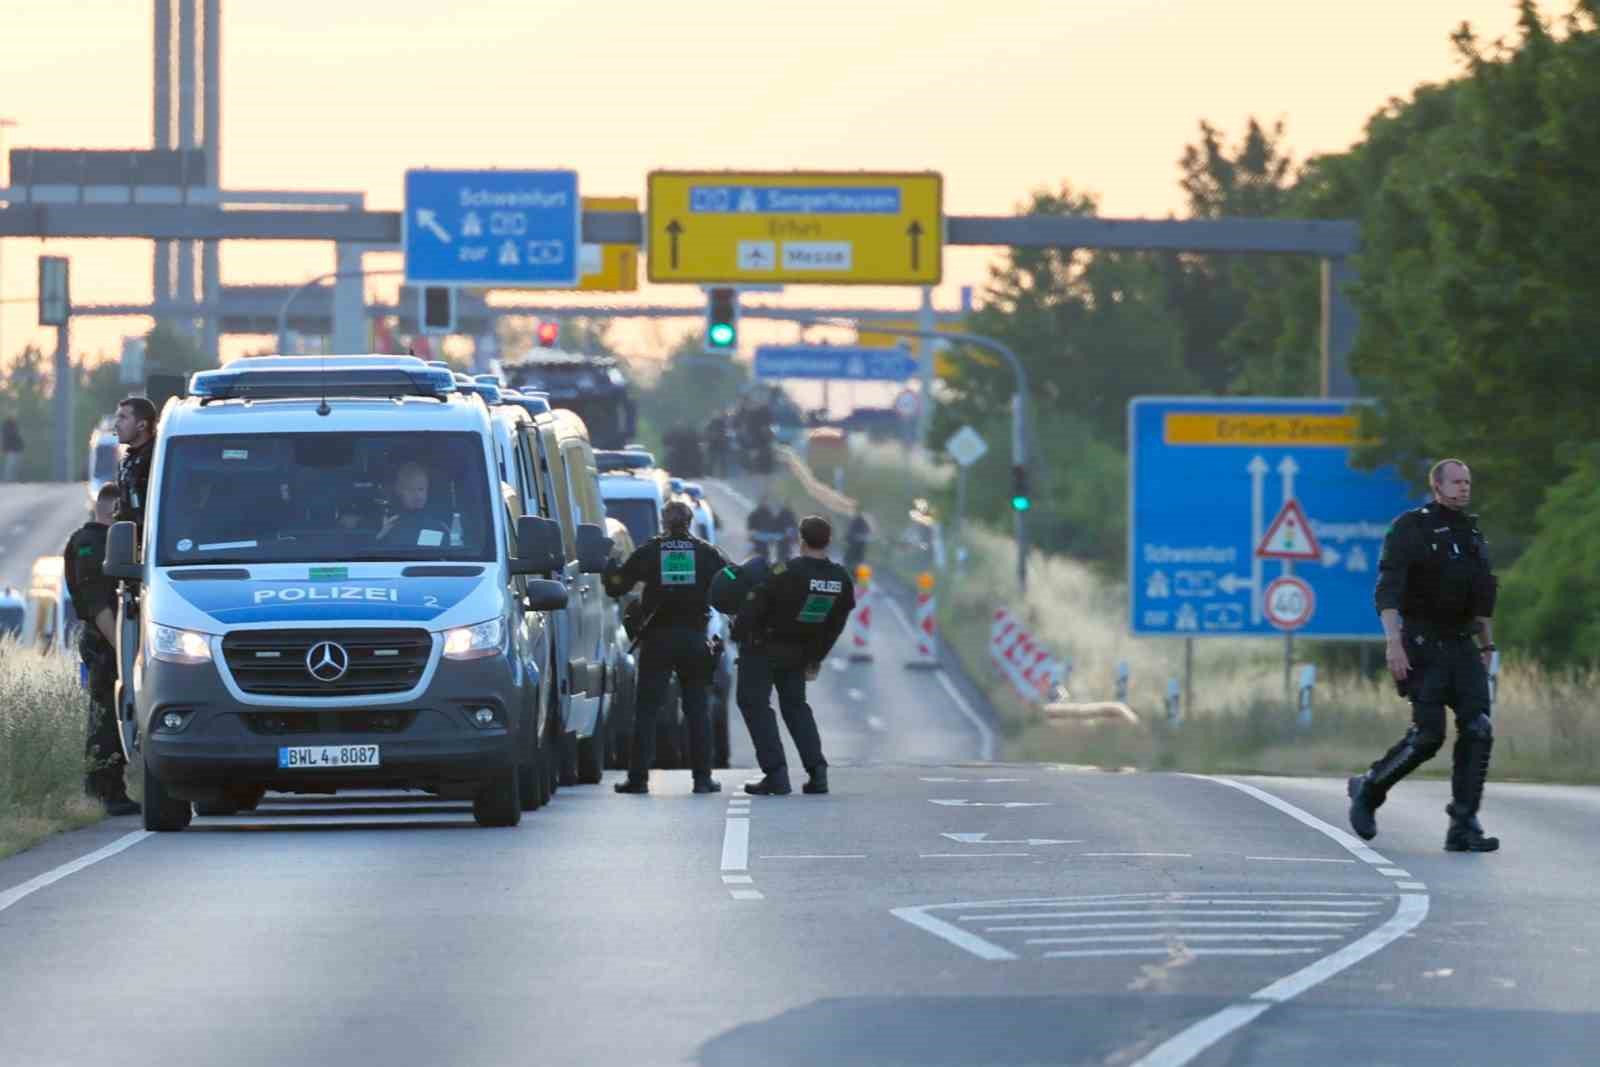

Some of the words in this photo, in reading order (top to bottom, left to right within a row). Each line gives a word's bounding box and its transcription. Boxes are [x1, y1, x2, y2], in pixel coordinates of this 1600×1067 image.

[660, 539, 694, 549] POLIZEI
[809, 578, 842, 593] POLIZEI
[253, 585, 398, 604] POLIZEI
[423, 595, 440, 608] 2
[1275, 592, 1302, 613] 40
[340, 746, 377, 764] 8087
